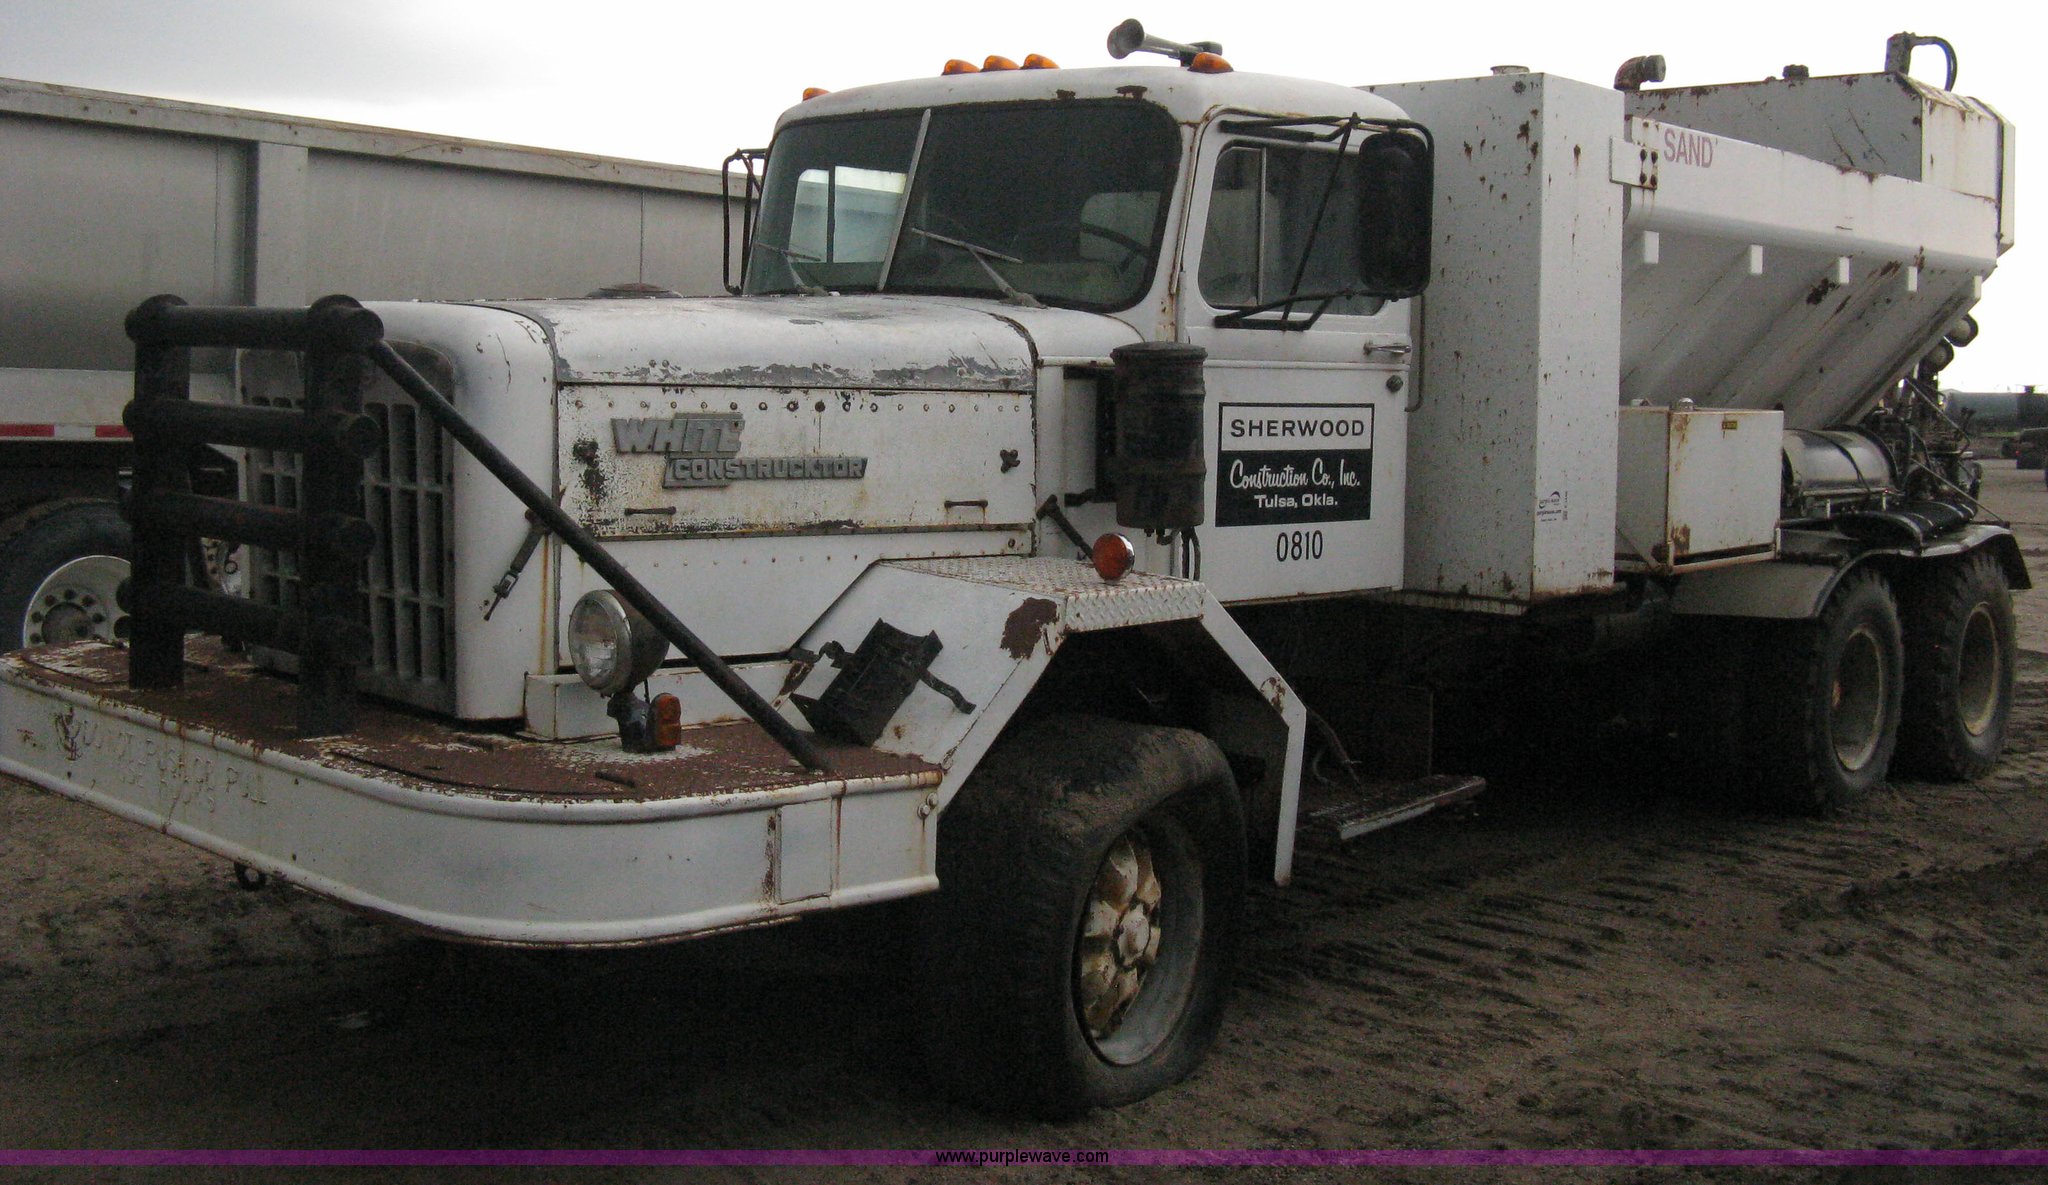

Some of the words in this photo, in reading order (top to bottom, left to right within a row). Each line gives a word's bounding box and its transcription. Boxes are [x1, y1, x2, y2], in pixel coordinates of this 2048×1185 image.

[1664, 128, 1713, 168] SAND
[611, 417, 745, 453] WHITE
[1231, 419, 1364, 437] SHERWOOD
[673, 458, 865, 480] CONSTRUCKTOR
[1230, 459, 1308, 489] Construction
[1312, 458, 1335, 488] Co.,
[1340, 459, 1361, 487] Inc.
[1254, 494, 1298, 508] Tulsa,
[1302, 493, 1338, 506] Okla.
[1276, 530, 1323, 562] 0810
